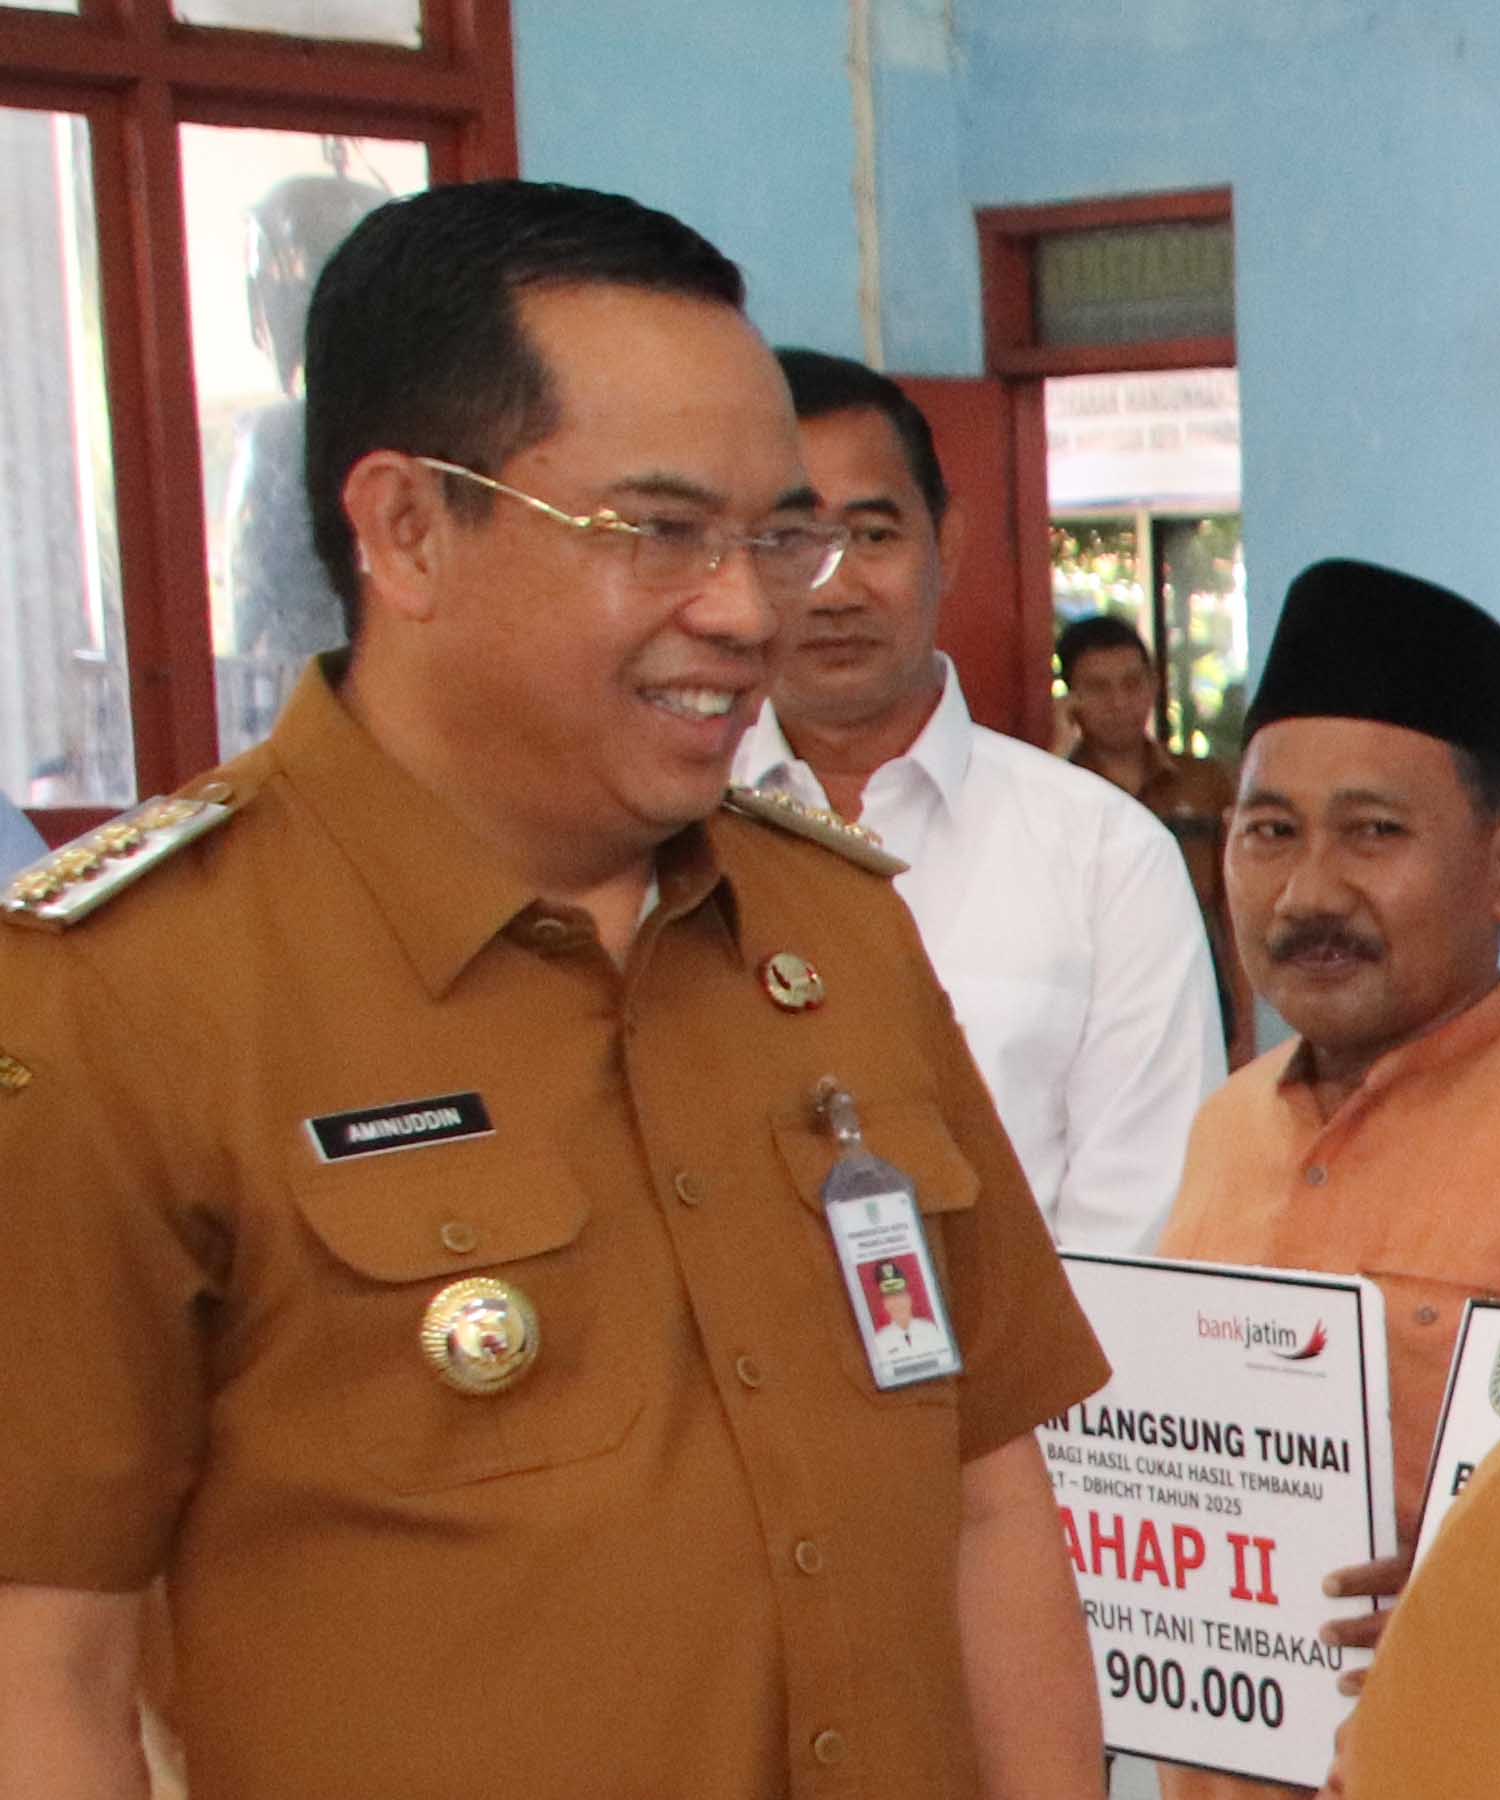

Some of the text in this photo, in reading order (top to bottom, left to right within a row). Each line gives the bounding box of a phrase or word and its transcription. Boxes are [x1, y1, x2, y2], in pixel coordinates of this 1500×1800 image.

[347, 1106, 462, 1143] AMINUDDIN
[1197, 1309, 1297, 1349] bankjatim
[1080, 1402, 1246, 1458] LANGSUNG
[1254, 1427, 1351, 1474] TUNAI
[1047, 1442, 1324, 1502] BAGI HASIL CUKAI HASIL TEMBAKAU
[1083, 1474, 1143, 1500] DBHCHT
[1148, 1484, 1201, 1509] TAHUN
[1205, 1493, 1243, 1516] 2025
[1226, 1530, 1281, 1607] II
[1140, 1608, 1194, 1645] TANI
[1202, 1618, 1344, 1672] TEMBAKAU
[1106, 1648, 1284, 1729] 900.000
